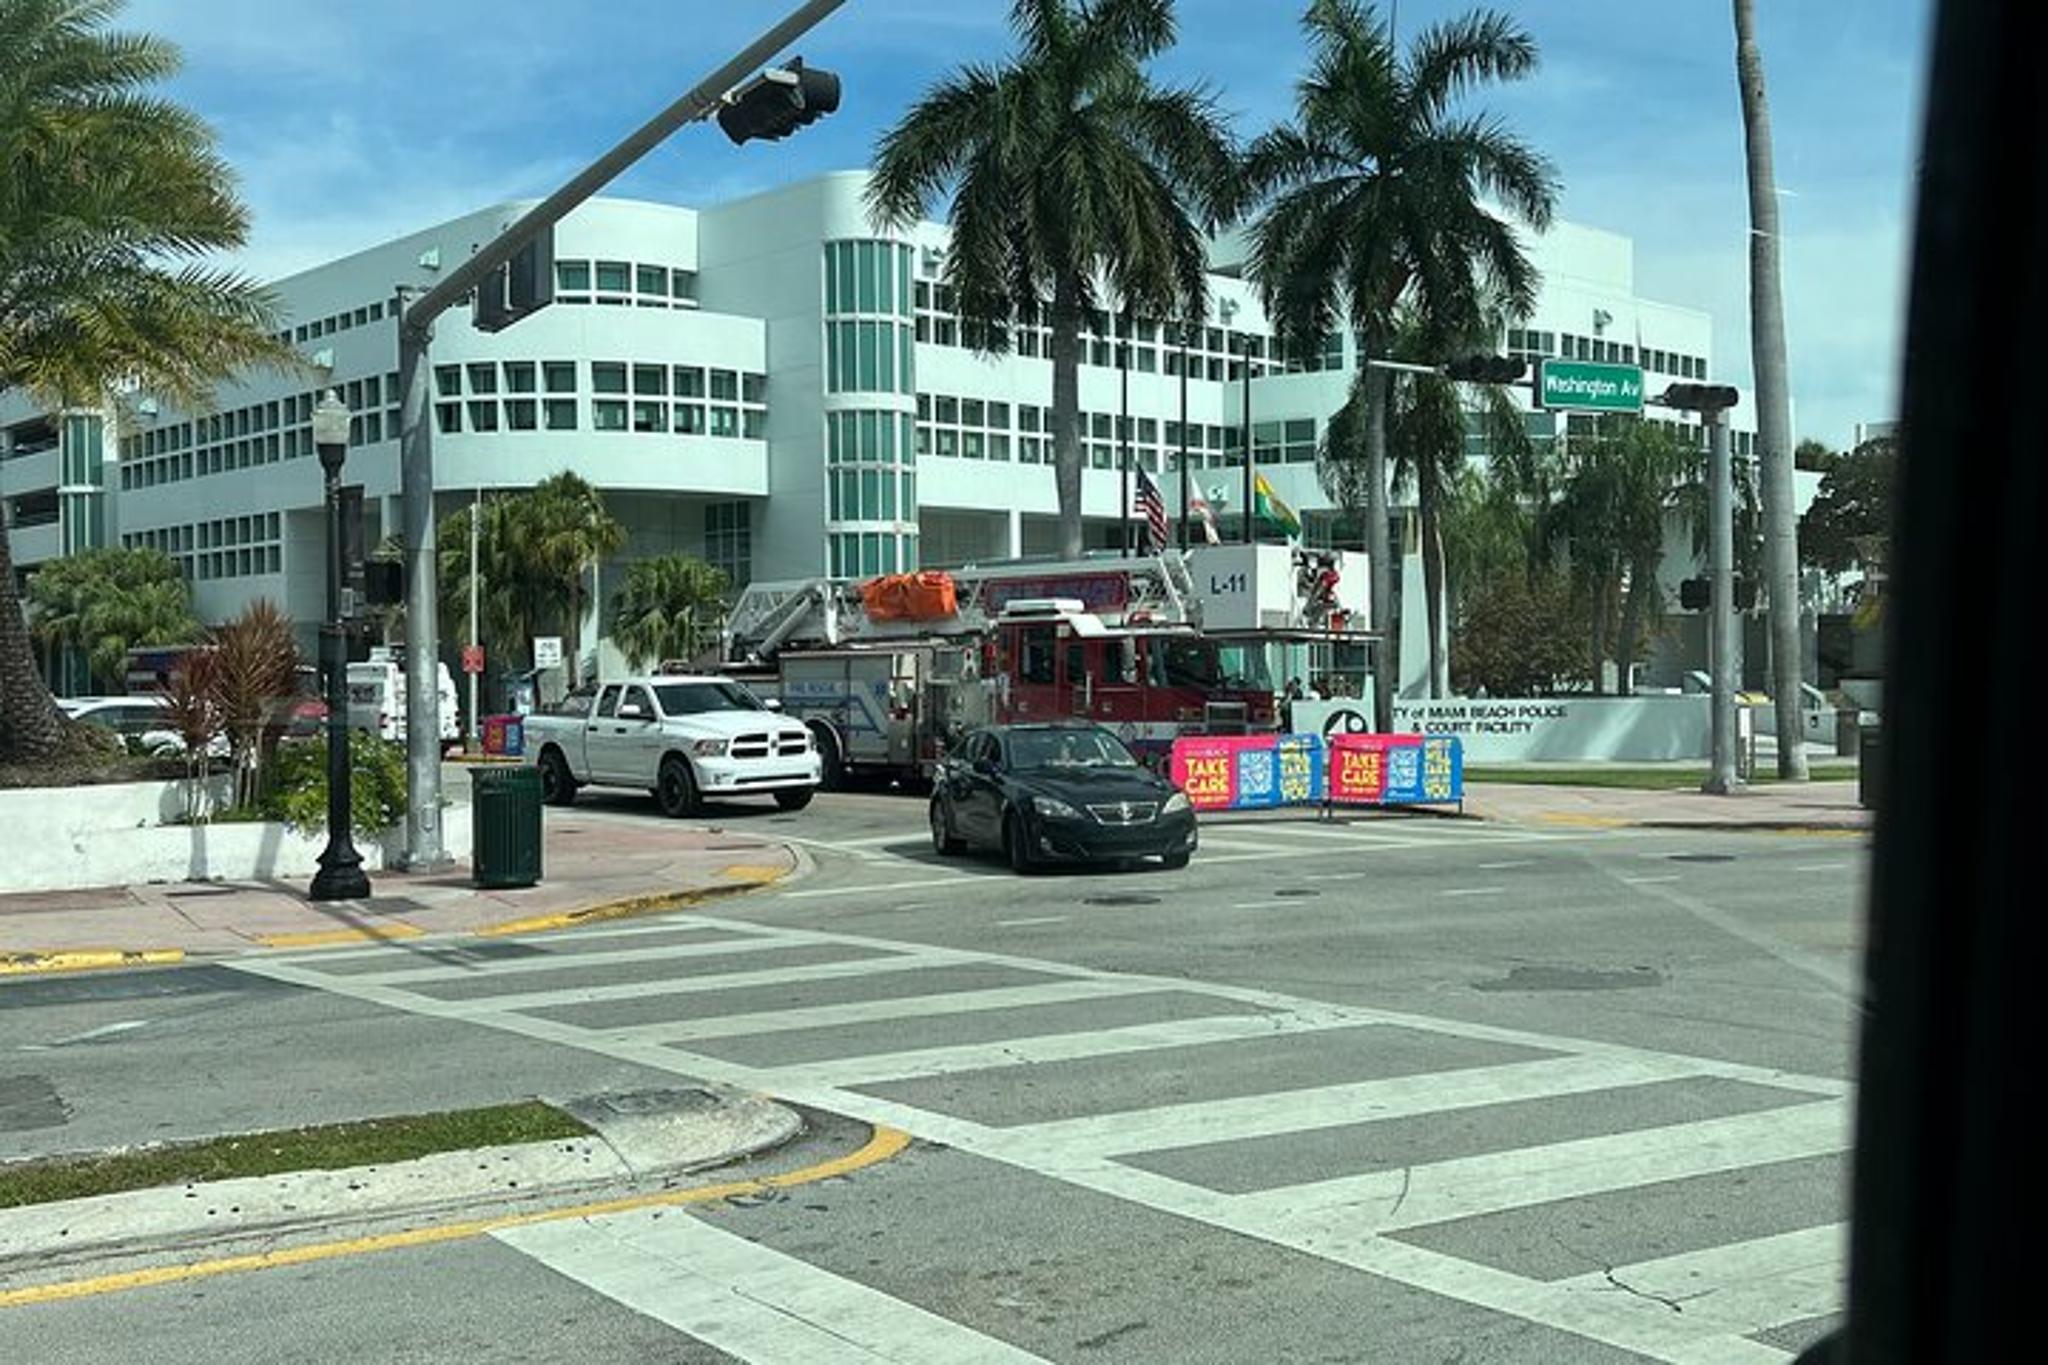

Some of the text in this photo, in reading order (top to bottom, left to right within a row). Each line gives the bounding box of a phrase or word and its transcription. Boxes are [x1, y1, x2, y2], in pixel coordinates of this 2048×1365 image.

[1546, 375, 1639, 400] Washington Av
[1211, 574, 1246, 595] L-11
[1393, 707, 1408, 718] TY
[1429, 705, 1466, 718] MIAMI
[1470, 705, 1515, 718] BEACH
[1519, 705, 1567, 718] POLICE
[1411, 721, 1533, 733] & COURT FACILITY
[1185, 758, 1229, 776] TAKE
[1342, 750, 1380, 768] TAKE
[1185, 777, 1229, 795] CARE
[1342, 769, 1380, 786] CARE
